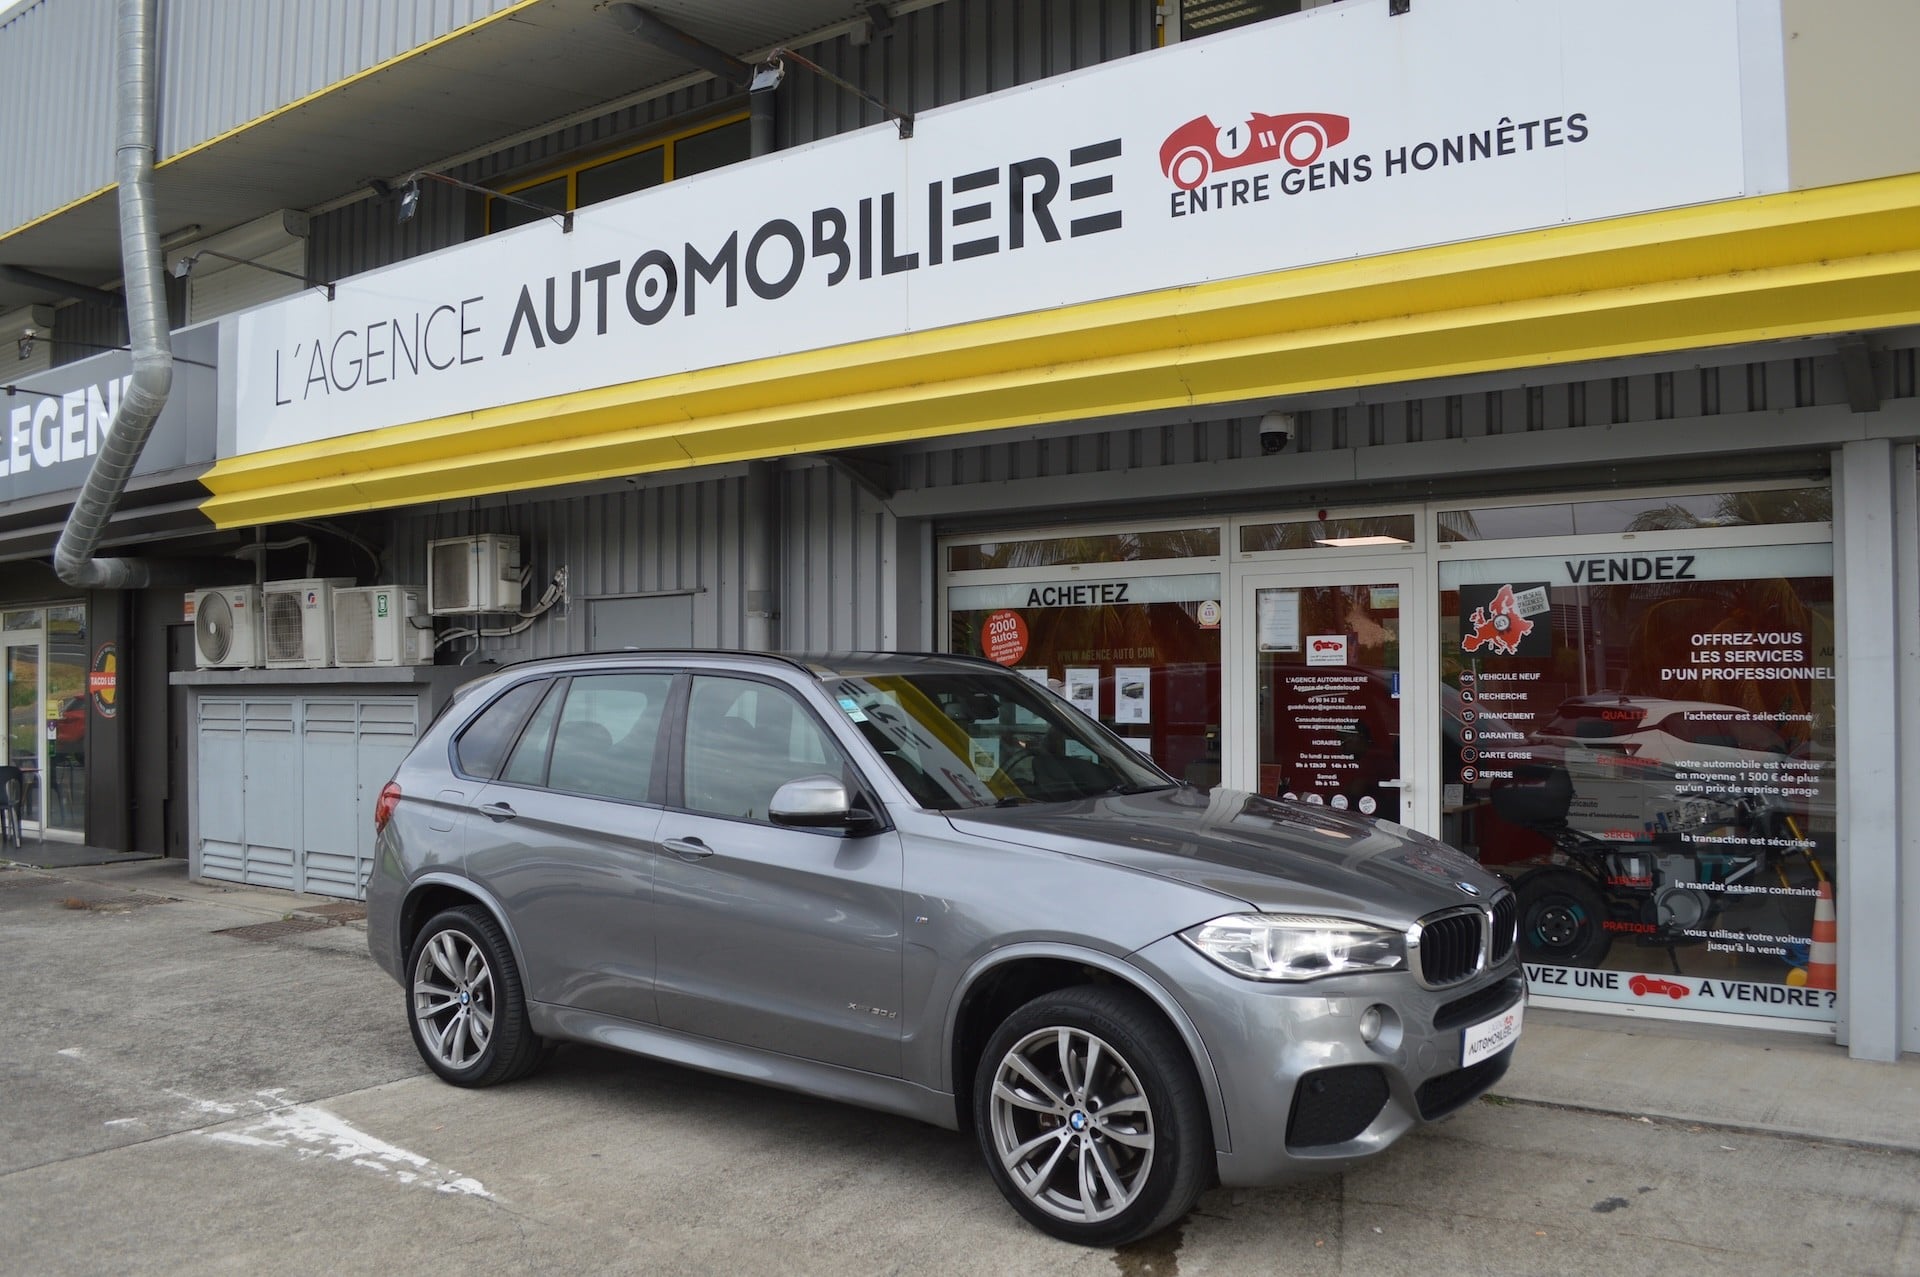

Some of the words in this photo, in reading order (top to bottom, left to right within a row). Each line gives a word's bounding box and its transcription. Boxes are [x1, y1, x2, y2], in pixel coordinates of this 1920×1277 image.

[1226, 126, 1238, 150] 1
[1171, 174, 1270, 218] ENTRE
[1280, 154, 1373, 196] GENS
[1385, 112, 1590, 175] HONNÊTES
[275, 296, 484, 406] L'AGENCE
[502, 138, 1123, 356] AUTOMOBILIERE
[0, 374, 133, 477] EGEN
[1565, 556, 1697, 583] VENDEZ
[1026, 583, 1130, 607] ACHETEZ
[989, 617, 1017, 635] 2000
[991, 630, 1019, 644] autos
[1690, 632, 1803, 647] OFFREZ-VOUS
[1690, 651, 1721, 664] LES
[1724, 650, 1804, 663] SERVICES
[1317, 676, 1368, 684] AUTOMOBILIERE
[1478, 673, 1518, 681] VEHICULE
[1519, 672, 1541, 681] NEUF
[1661, 669, 1698, 681] D'UN
[1702, 667, 1836, 680] PROFESSIONNEL
[1478, 693, 1528, 701] RECHERCHE
[1478, 712, 1536, 720] FINANCEMENT
[1683, 711, 1732, 721] l'acheteur
[1735, 712, 1751, 721] est
[1752, 711, 1813, 722] sélectionné
[1478, 732, 1525, 740] GARANTIES
[1479, 751, 1506, 759] CARTE
[1507, 752, 1533, 760] GRISE
[1674, 760, 1701, 768] votre
[1702, 760, 1761, 770] automobile
[1763, 762, 1779, 770] est
[1780, 761, 1821, 771] vendue
[1479, 771, 1514, 779] REPRISE
[1675, 772, 1688, 780] en
[1689, 772, 1737, 783] moyenne
[1748, 772, 1769, 783] 500
[1771, 773, 1779, 782] €
[1780, 773, 1795, 783] de
[1796, 774, 1820, 785] plus
[1674, 784, 1704, 794] qu'un
[1705, 785, 1726, 794] prix
[1727, 785, 1741, 794] de
[1743, 785, 1780, 796] reprise
[1781, 787, 1820, 798] garage
[1680, 832, 1690, 842] la
[1692, 833, 1748, 845] transaction
[1750, 836, 1766, 846] est
[1767, 836, 1817, 848] sécurisée
[1675, 879, 1685, 889] le
[1686, 881, 1726, 892] mandat
[1727, 884, 1743, 893] est
[1744, 885, 1767, 894] sans
[1769, 886, 1822, 898] contrainte
[1602, 921, 1657, 933] PRATIQUE
[1683, 929, 1708, 939] vous
[1709, 929, 1745, 940] utilisez
[1746, 932, 1773, 943] votre
[1775, 934, 1812, 945] voiture
[1707, 941, 1744, 953] jusqu'à
[1746, 942, 1756, 953] la
[1757, 946, 1787, 956] vente
[1525, 965, 1568, 985] VEZ
[1575, 969, 1619, 990] UNE
[1698, 980, 1714, 998] A
[1720, 982, 1820, 1008] VENDRE
